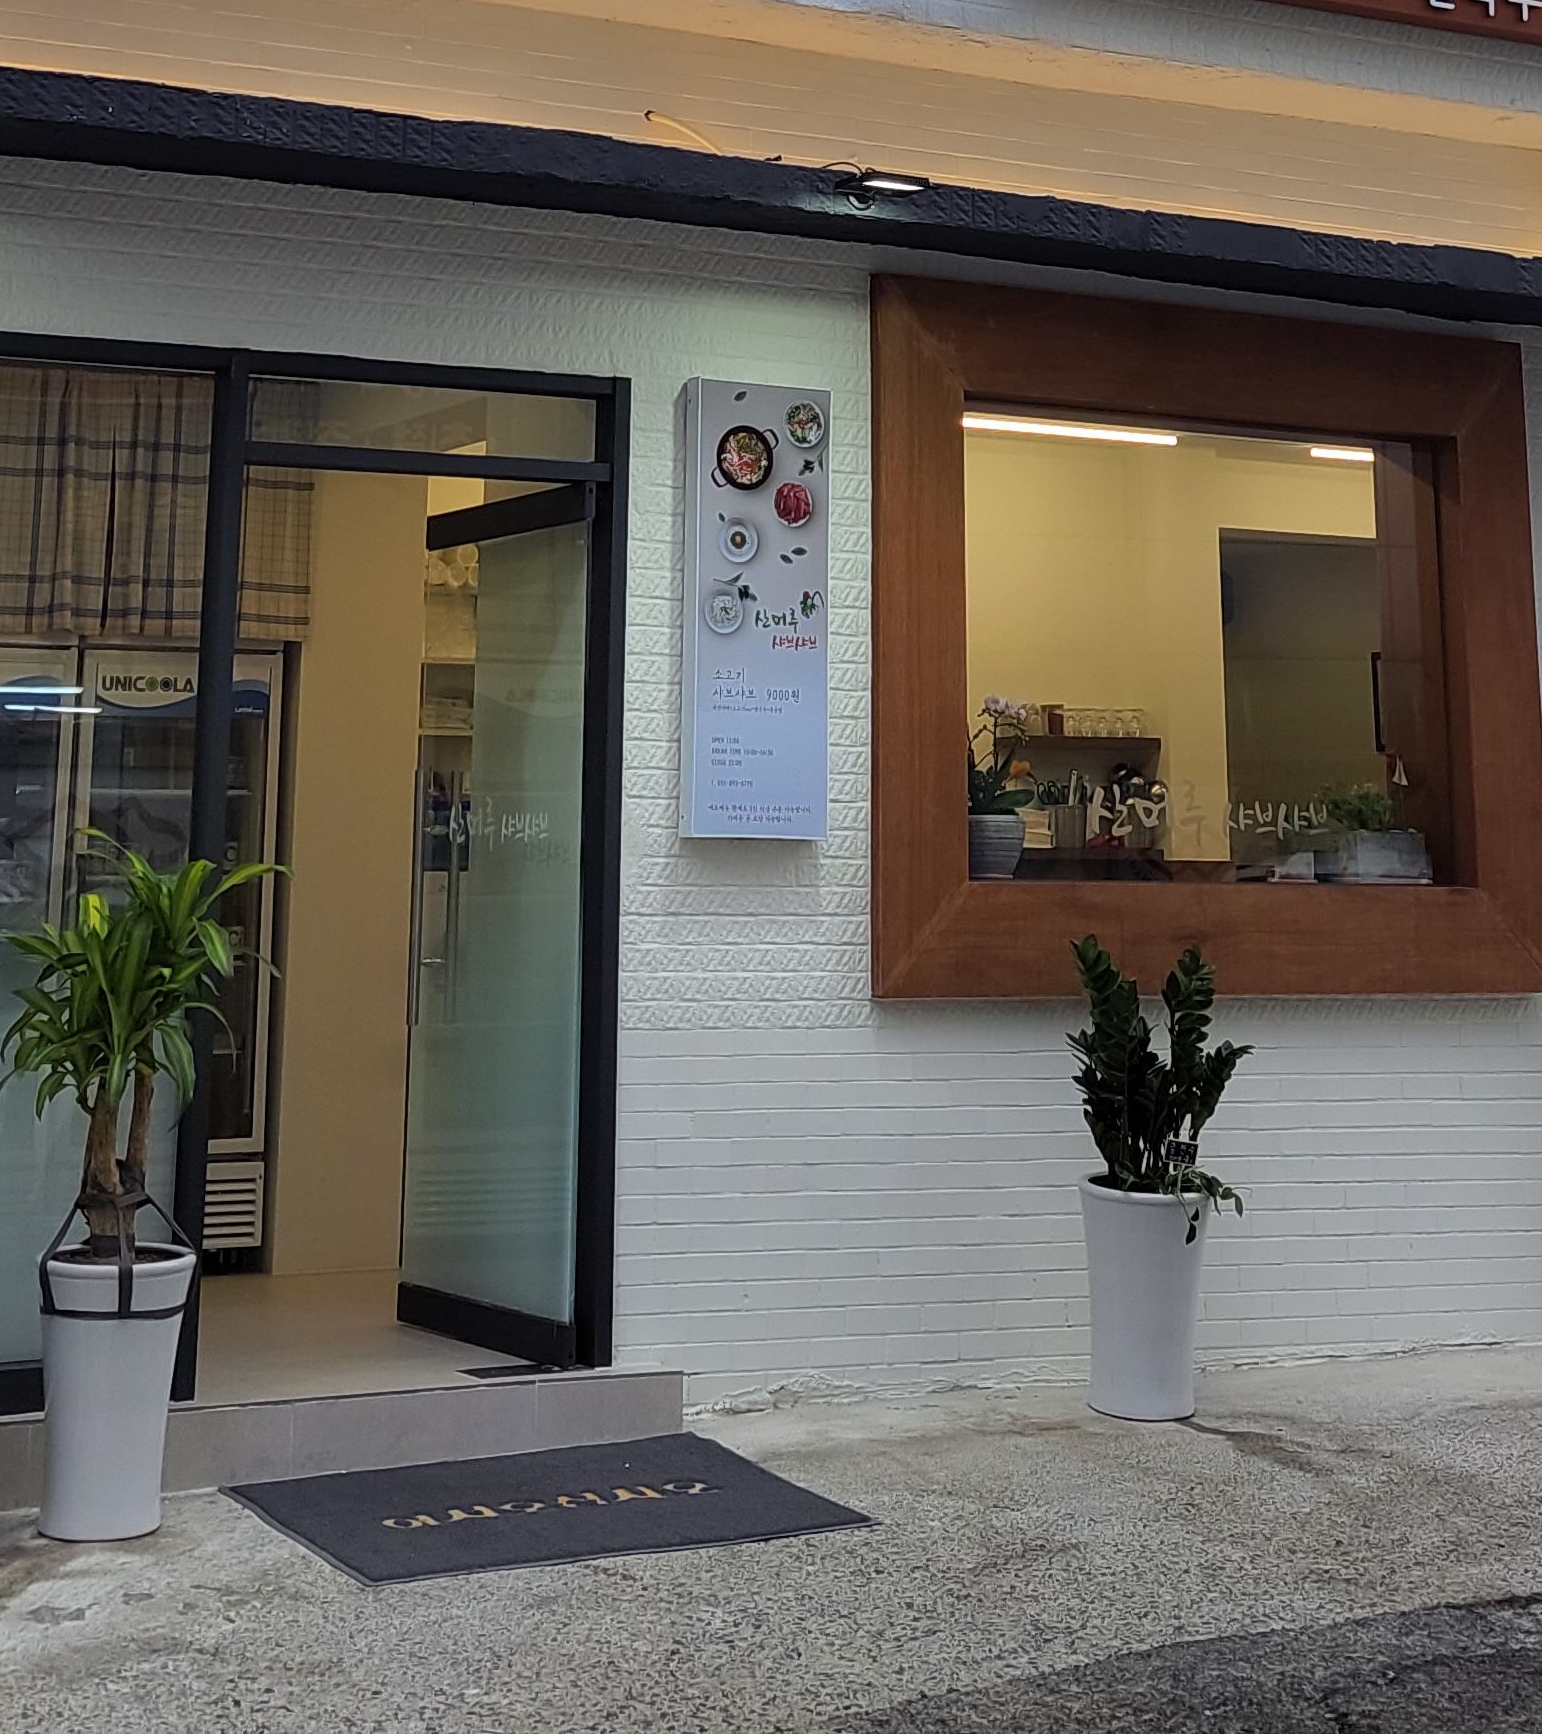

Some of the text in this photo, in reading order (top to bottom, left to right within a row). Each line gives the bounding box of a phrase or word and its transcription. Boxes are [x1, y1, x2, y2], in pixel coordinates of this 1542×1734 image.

[755, 607, 799, 634] 산머루
[772, 635, 818, 651] 샤브샤브
[102, 675, 195, 693] UNICOOLA
[712, 667, 746, 684] 소고기
[712, 684, 800, 703] 샤브샤브 9000원
[501, 811, 550, 843] 샤브샤브
[1225, 799, 1331, 841] 샤브샤브
